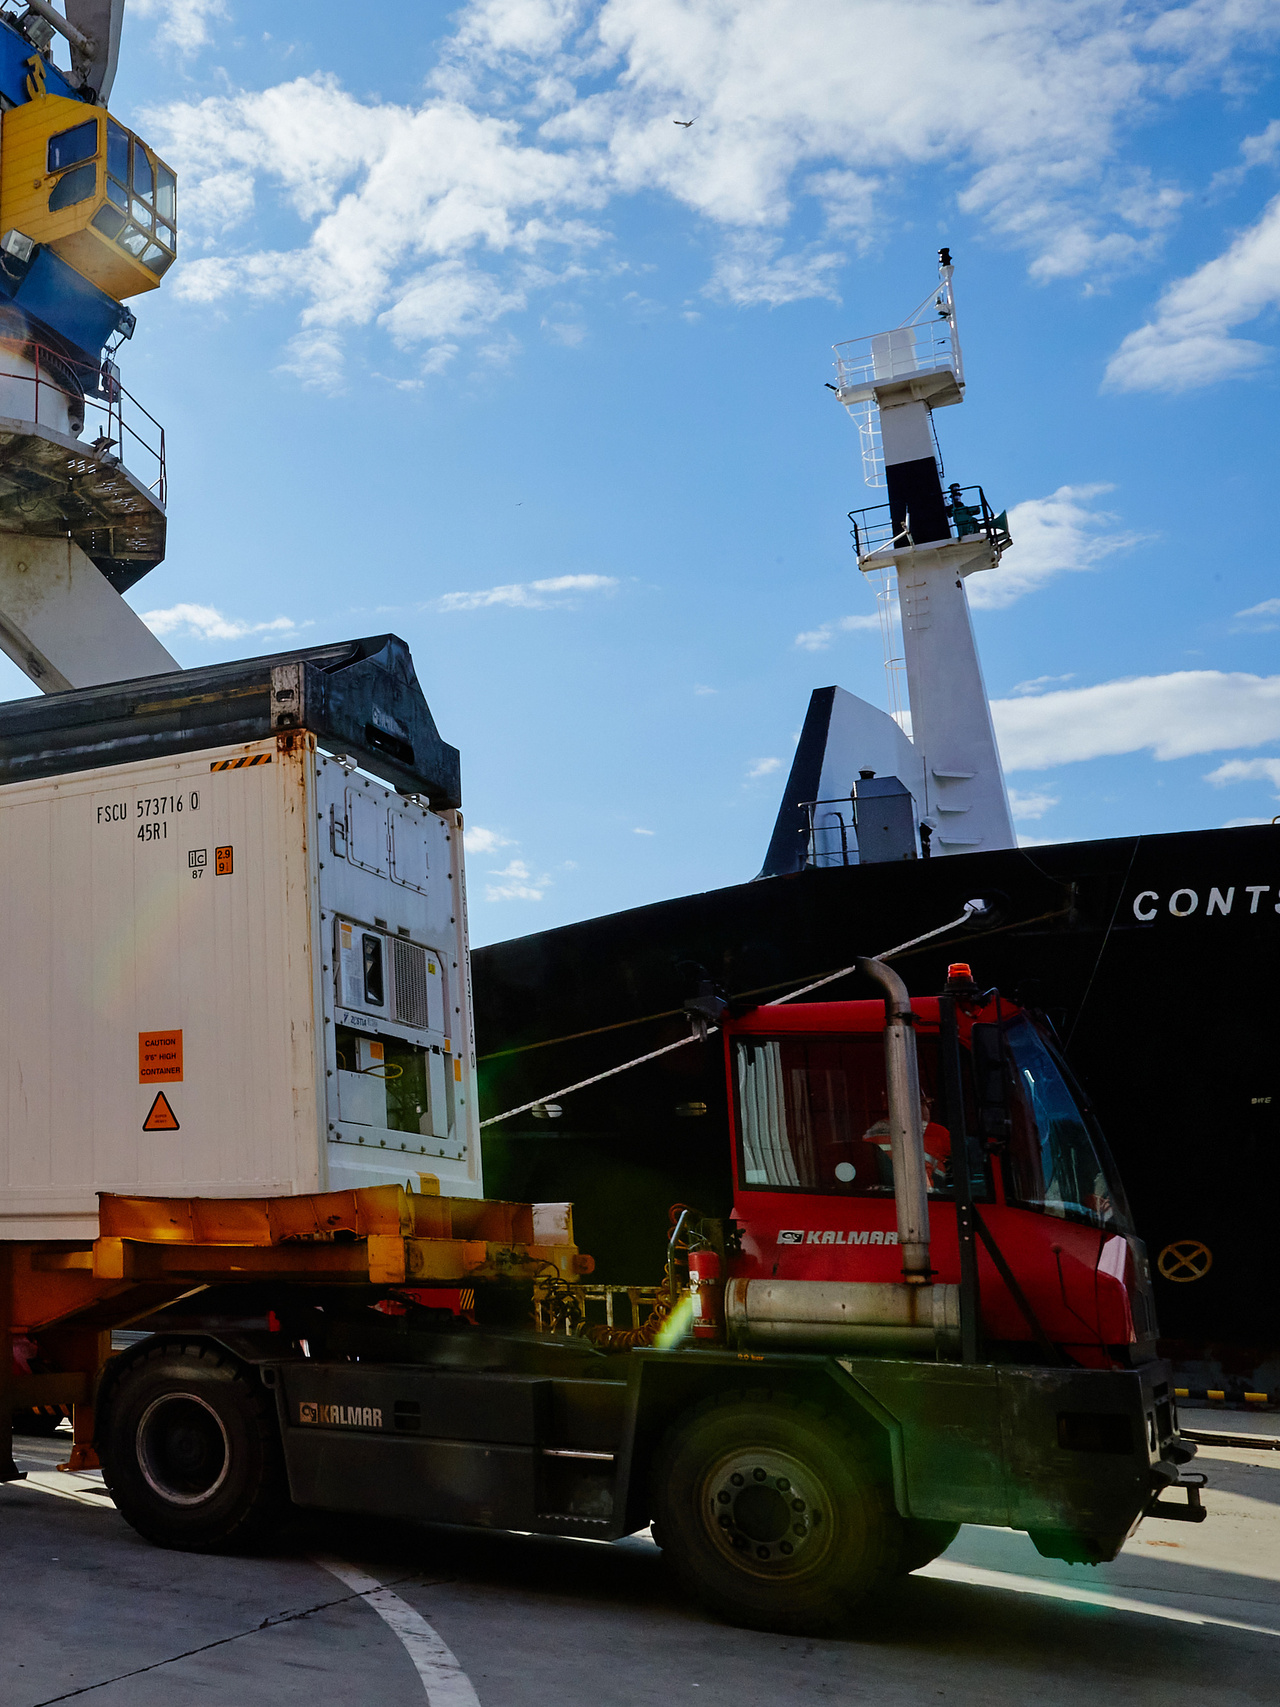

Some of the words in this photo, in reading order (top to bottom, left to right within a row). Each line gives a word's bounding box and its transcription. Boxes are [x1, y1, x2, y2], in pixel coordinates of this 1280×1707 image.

[97, 803, 127, 824] FSCU
[137, 795, 183, 818] 573716
[190, 791, 200, 811] 0
[137, 822, 167, 842] 45R1
[217, 850, 231, 860] 2.9
[192, 869, 204, 879] 87
[1133, 885, 1280, 921] CONT
[145, 1039, 176, 1047] CAUTION
[141, 1067, 181, 1076] CONTAINER
[806, 1231, 898, 1245] KALMAR
[320, 1404, 383, 1427] KALMAR
